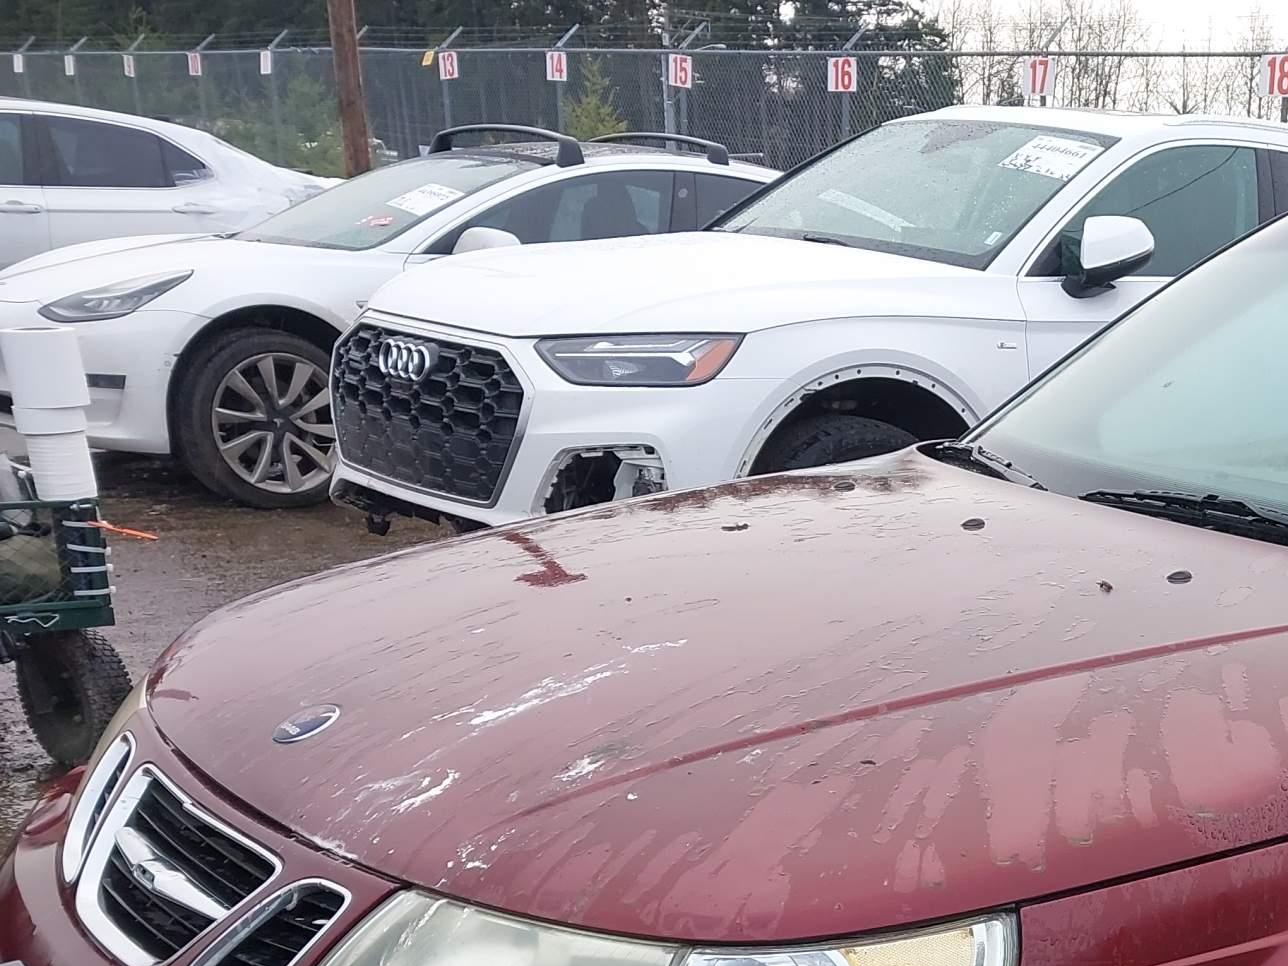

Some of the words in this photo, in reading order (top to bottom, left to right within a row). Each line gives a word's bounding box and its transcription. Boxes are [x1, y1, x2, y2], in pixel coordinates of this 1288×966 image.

[441, 53, 455, 78] 13
[551, 53, 563, 79] 14
[672, 56, 688, 86] 15
[833, 58, 852, 90] 16
[1030, 59, 1049, 94] 17
